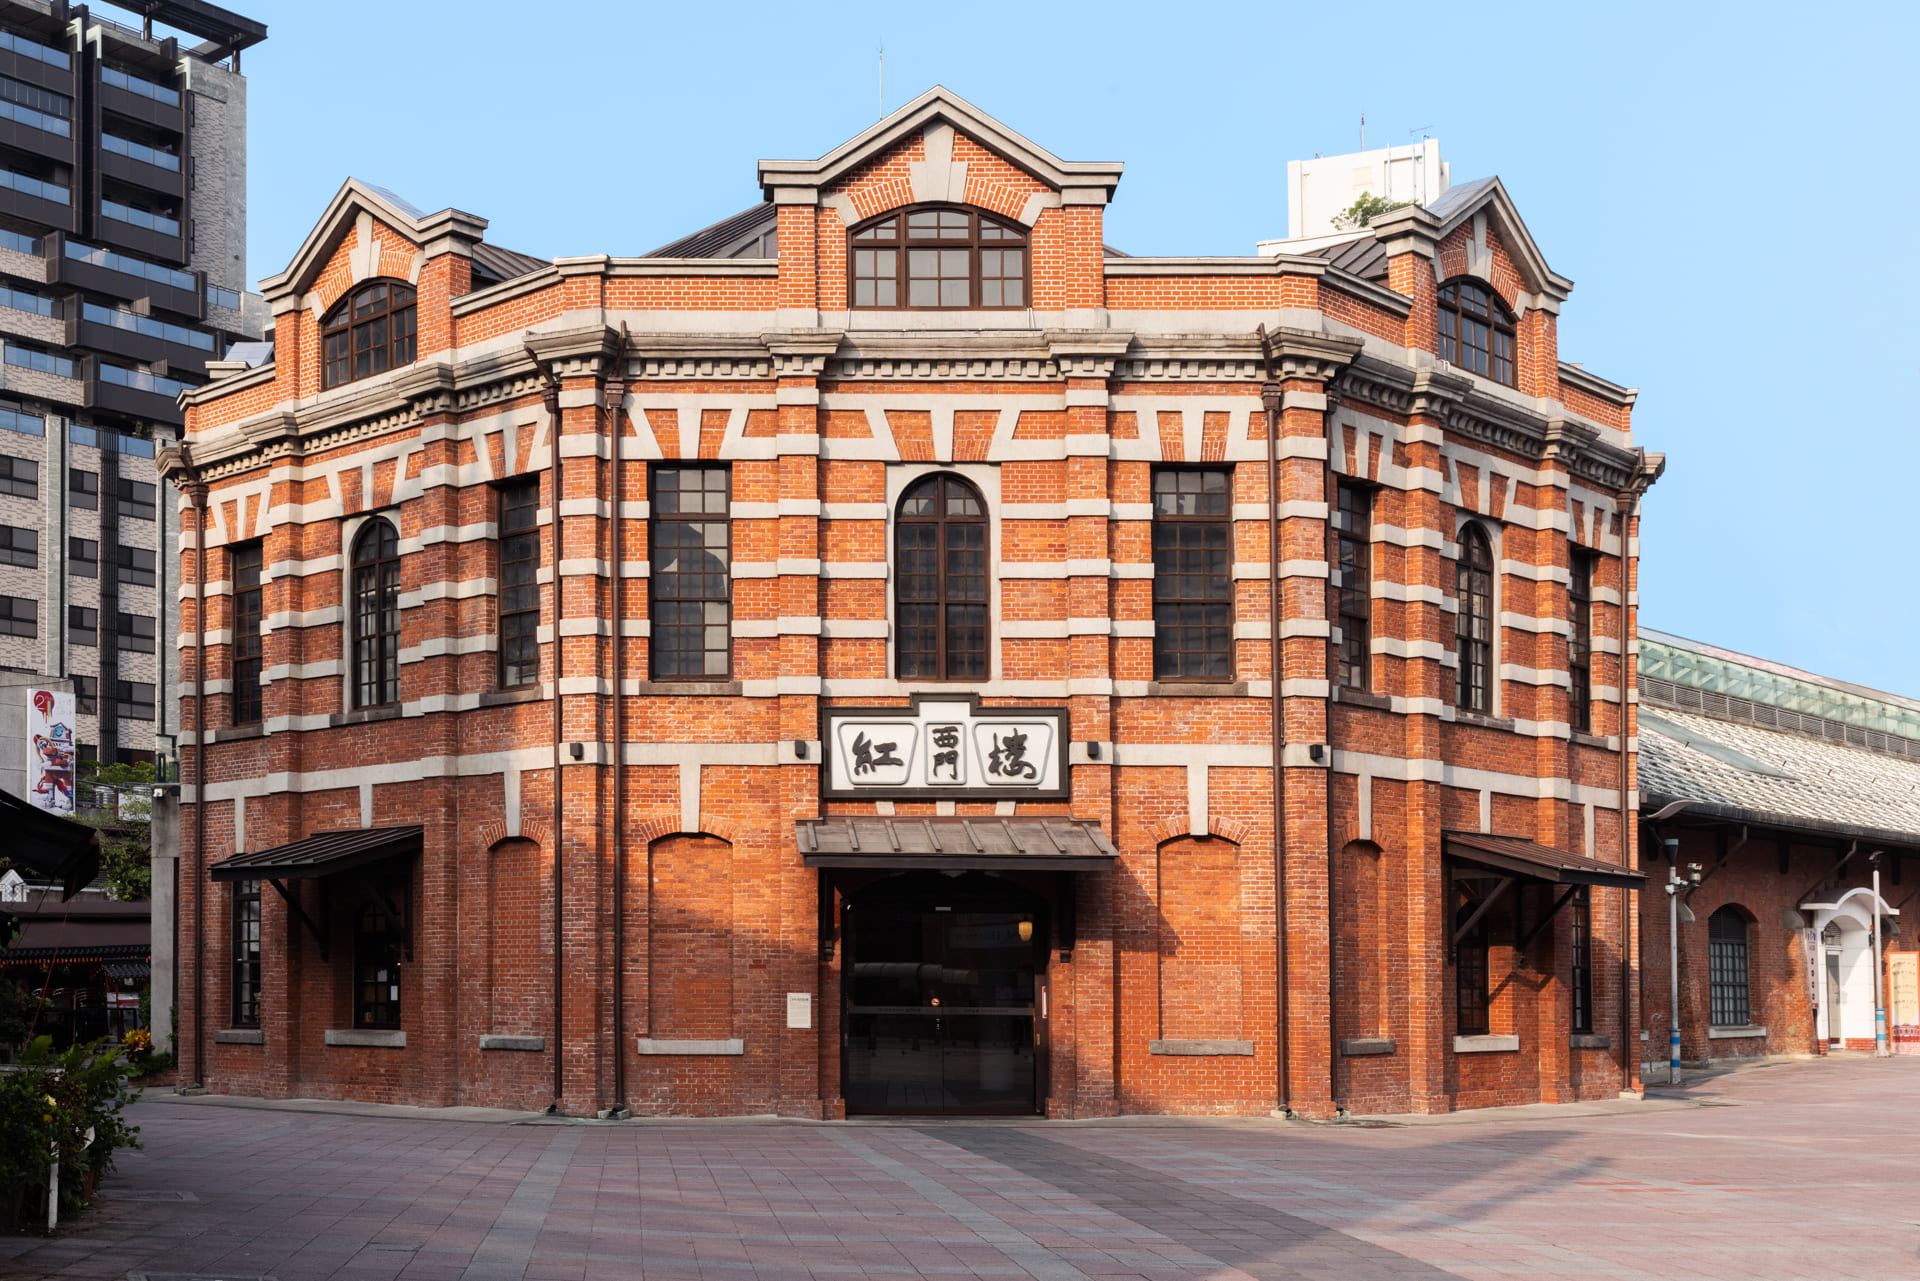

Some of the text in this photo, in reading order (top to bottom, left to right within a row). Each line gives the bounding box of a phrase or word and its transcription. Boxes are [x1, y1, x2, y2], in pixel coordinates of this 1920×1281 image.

[852, 726, 1036, 780] 紅 西門 樓
